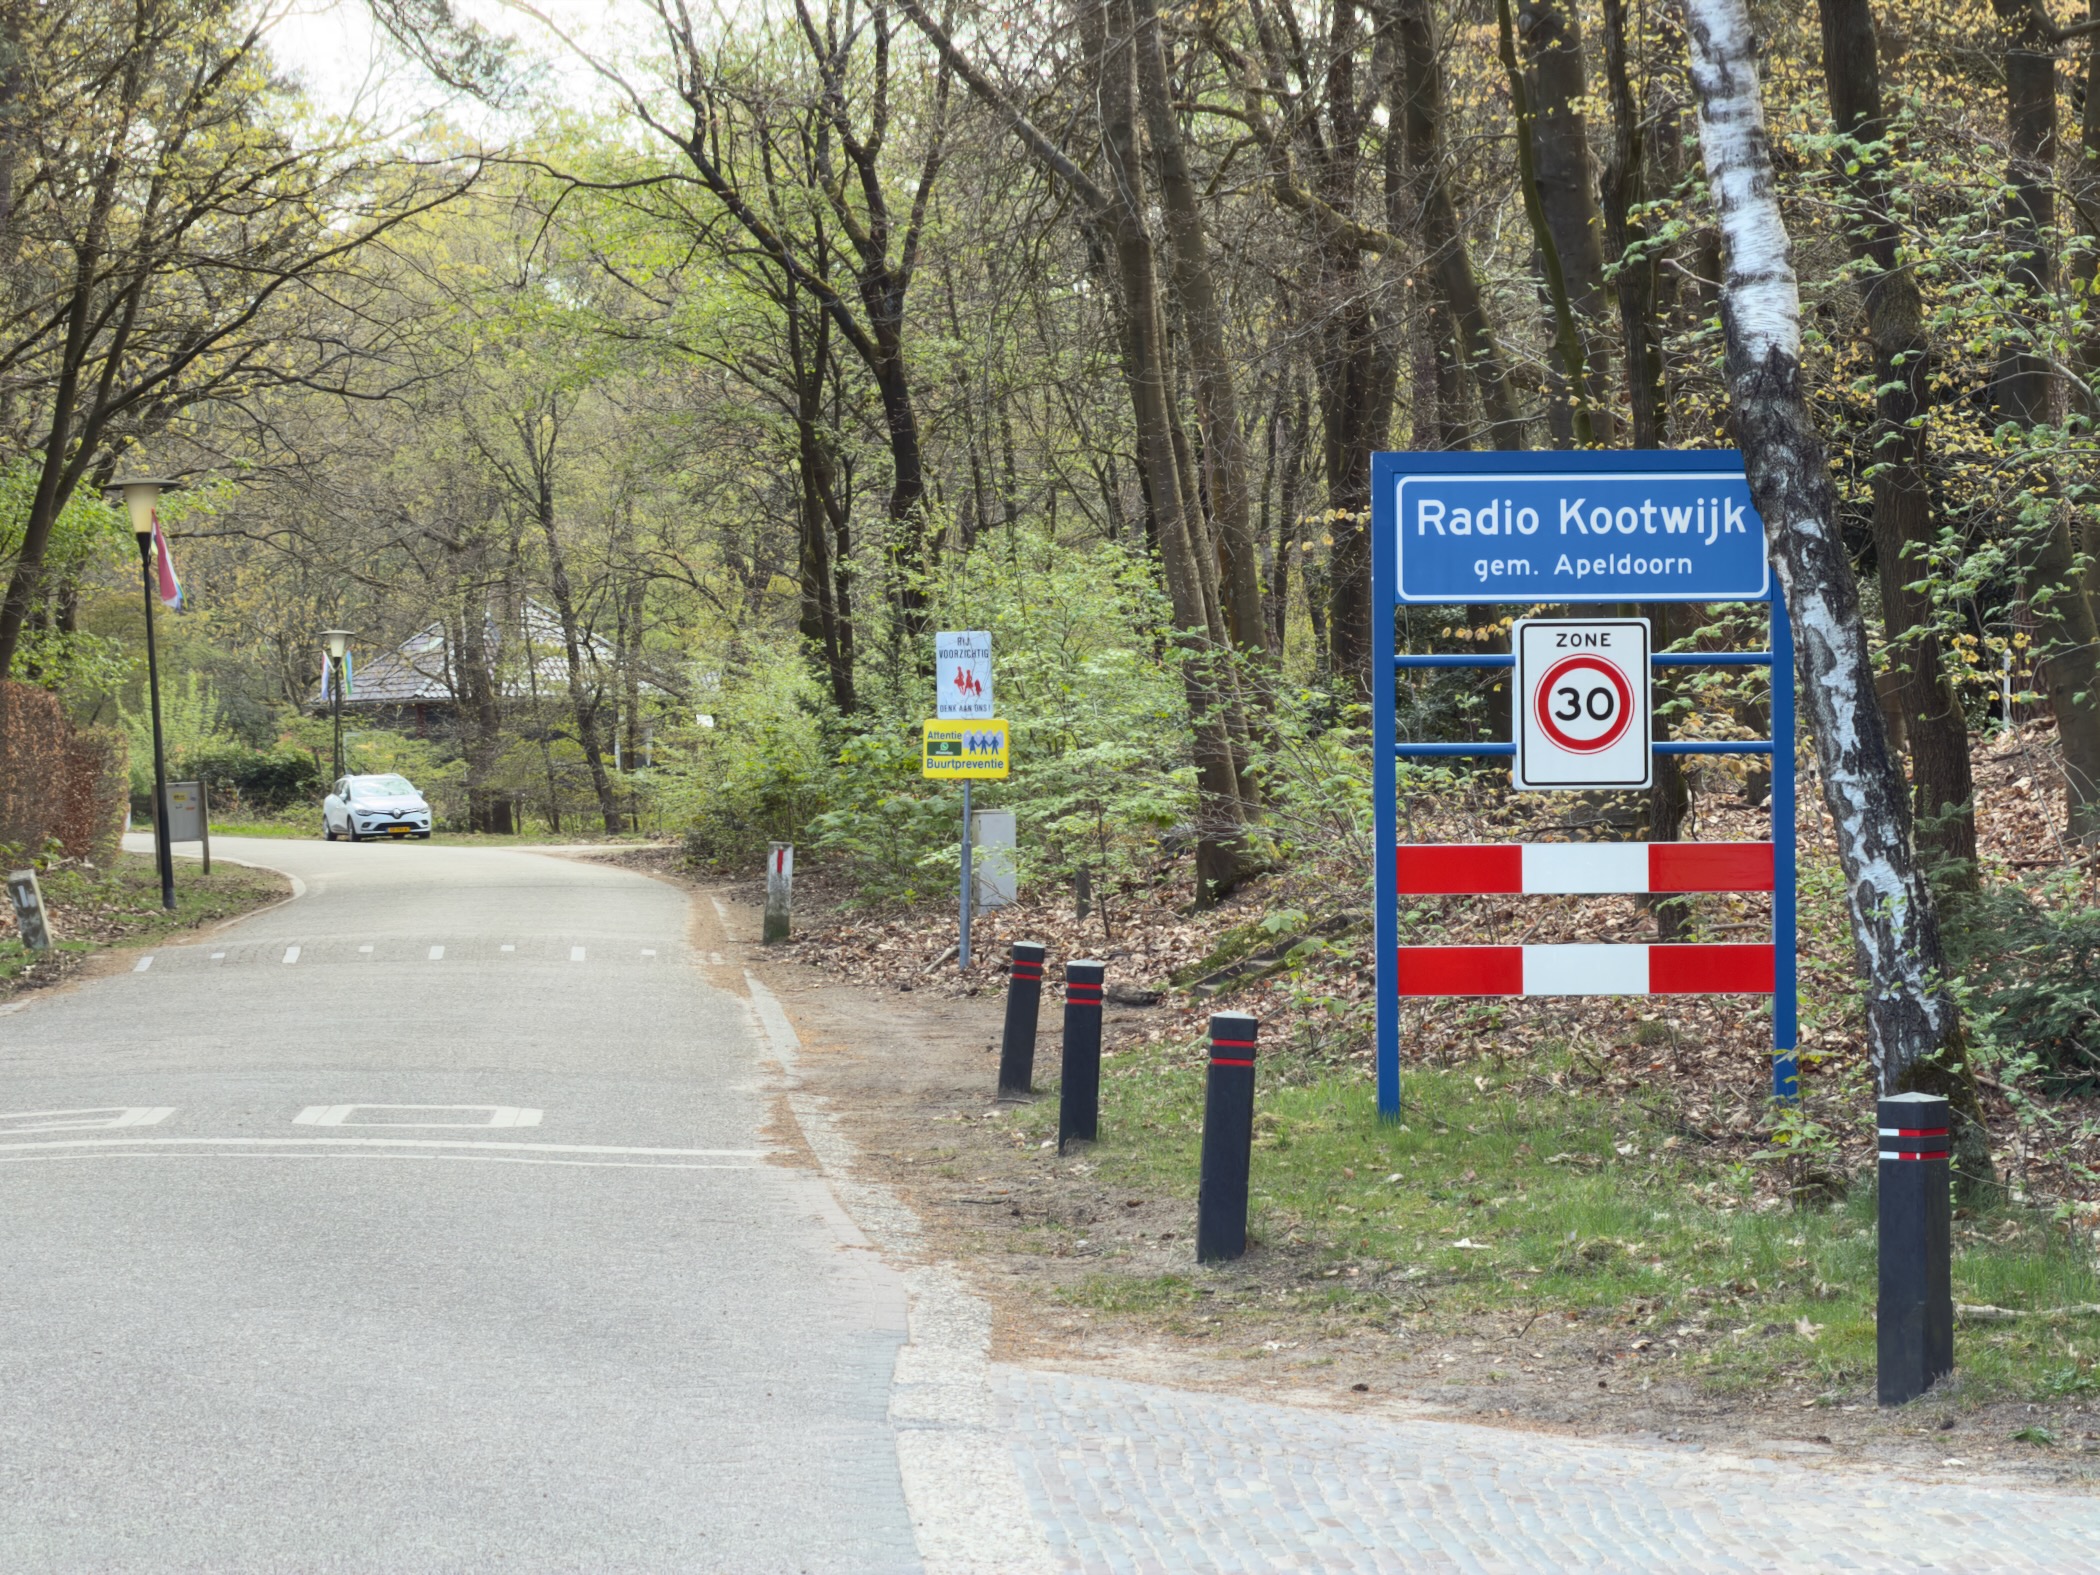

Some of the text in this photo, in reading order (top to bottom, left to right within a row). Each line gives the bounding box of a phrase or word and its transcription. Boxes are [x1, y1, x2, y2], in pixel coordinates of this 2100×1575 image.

[1418, 497, 1747, 546] Radio Kootwijk
[1474, 553, 1693, 583] gem. Apeldoorn
[957, 636, 970, 646] RIJ
[1556, 633, 1612, 648] ZONE
[938, 649, 989, 659] VOORZICHTIG
[940, 704, 957, 713] DENK
[959, 704, 972, 712] AAN
[1555, 687, 1615, 721] 30
[928, 730, 963, 740] Attentie
[926, 758, 1004, 771] Buurtpreventie
